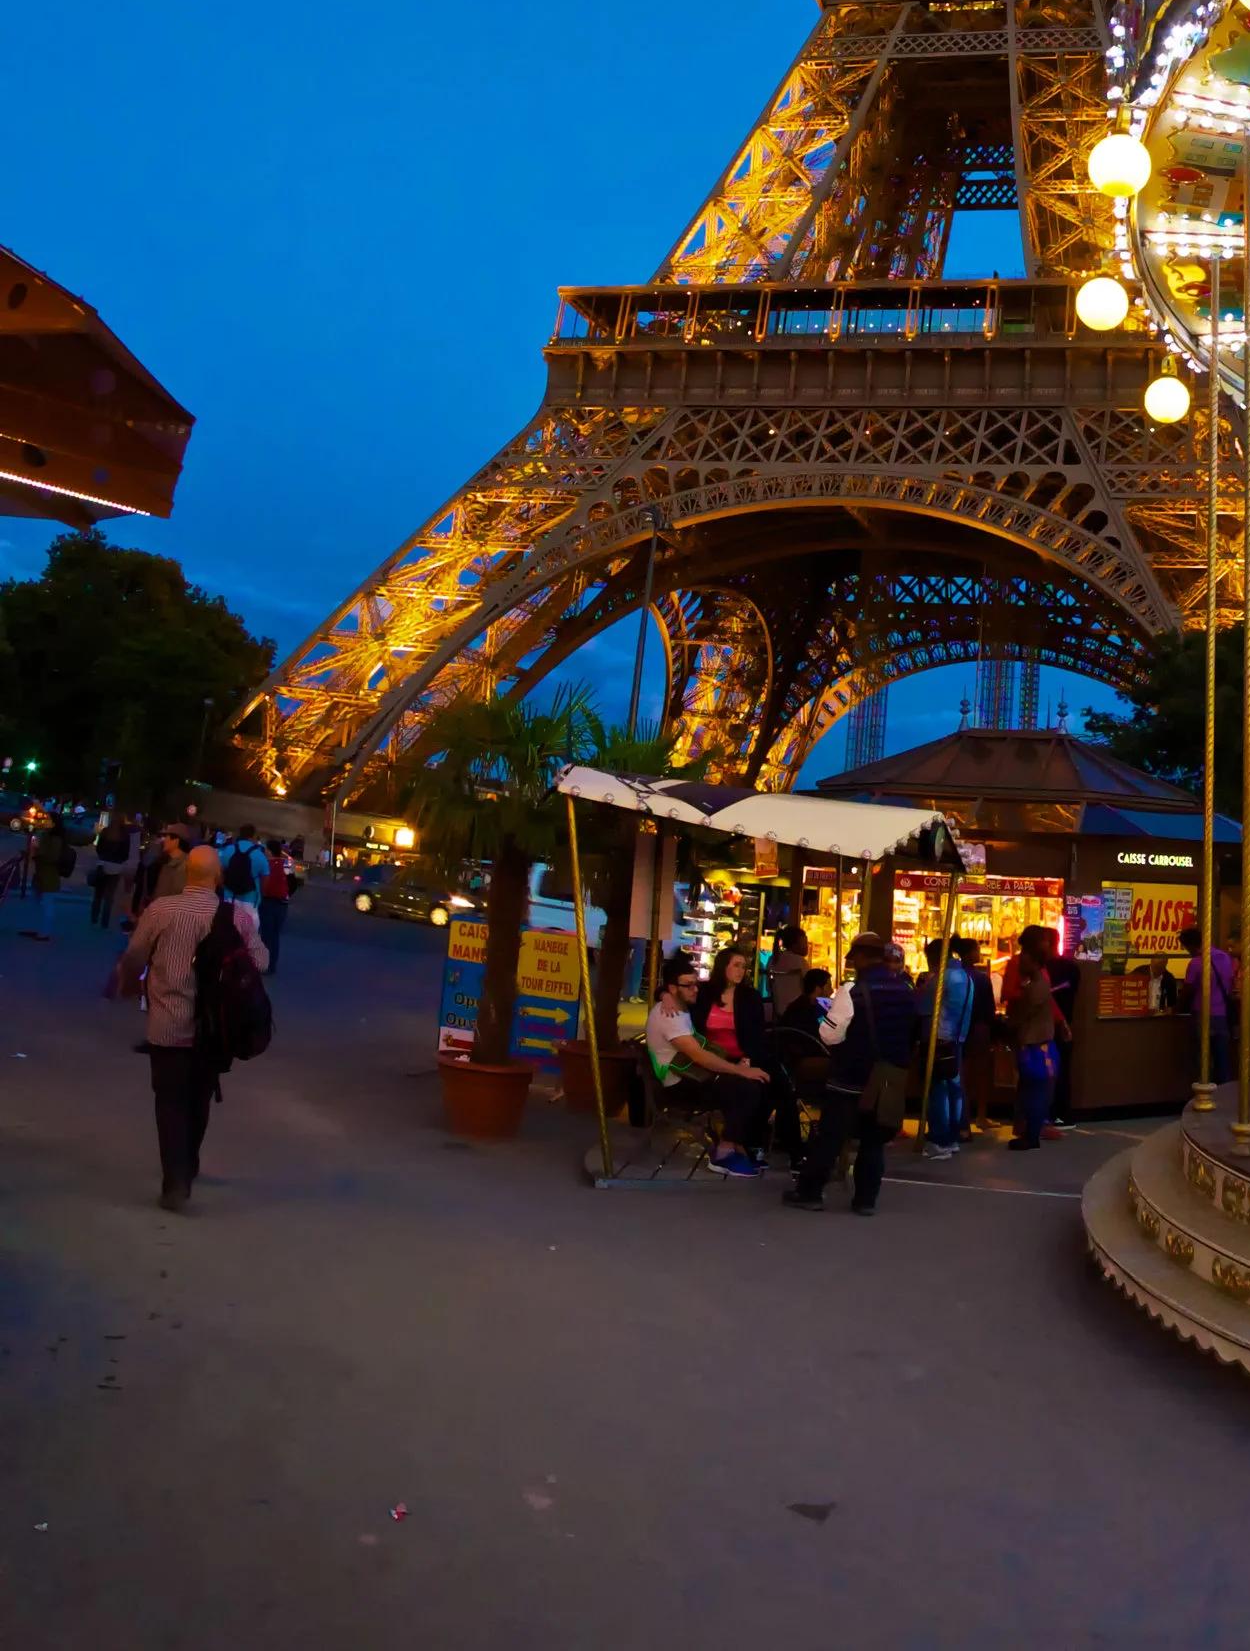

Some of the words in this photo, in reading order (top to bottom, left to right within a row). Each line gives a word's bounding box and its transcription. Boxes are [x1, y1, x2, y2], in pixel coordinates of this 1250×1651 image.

[1117, 852, 1146, 865] CAISSE
[1148, 854, 1194, 868] CARROUSEL
[1013, 880, 1036, 892] PAPA
[1132, 898, 1194, 932] CAISSE
[458, 922, 489, 940] CAIS
[452, 943, 488, 961] MANE
[537, 958, 548, 972] DE
[550, 961, 561, 974] LA
[521, 976, 544, 992] TOUR
[545, 979, 574, 996] EIFFEL
